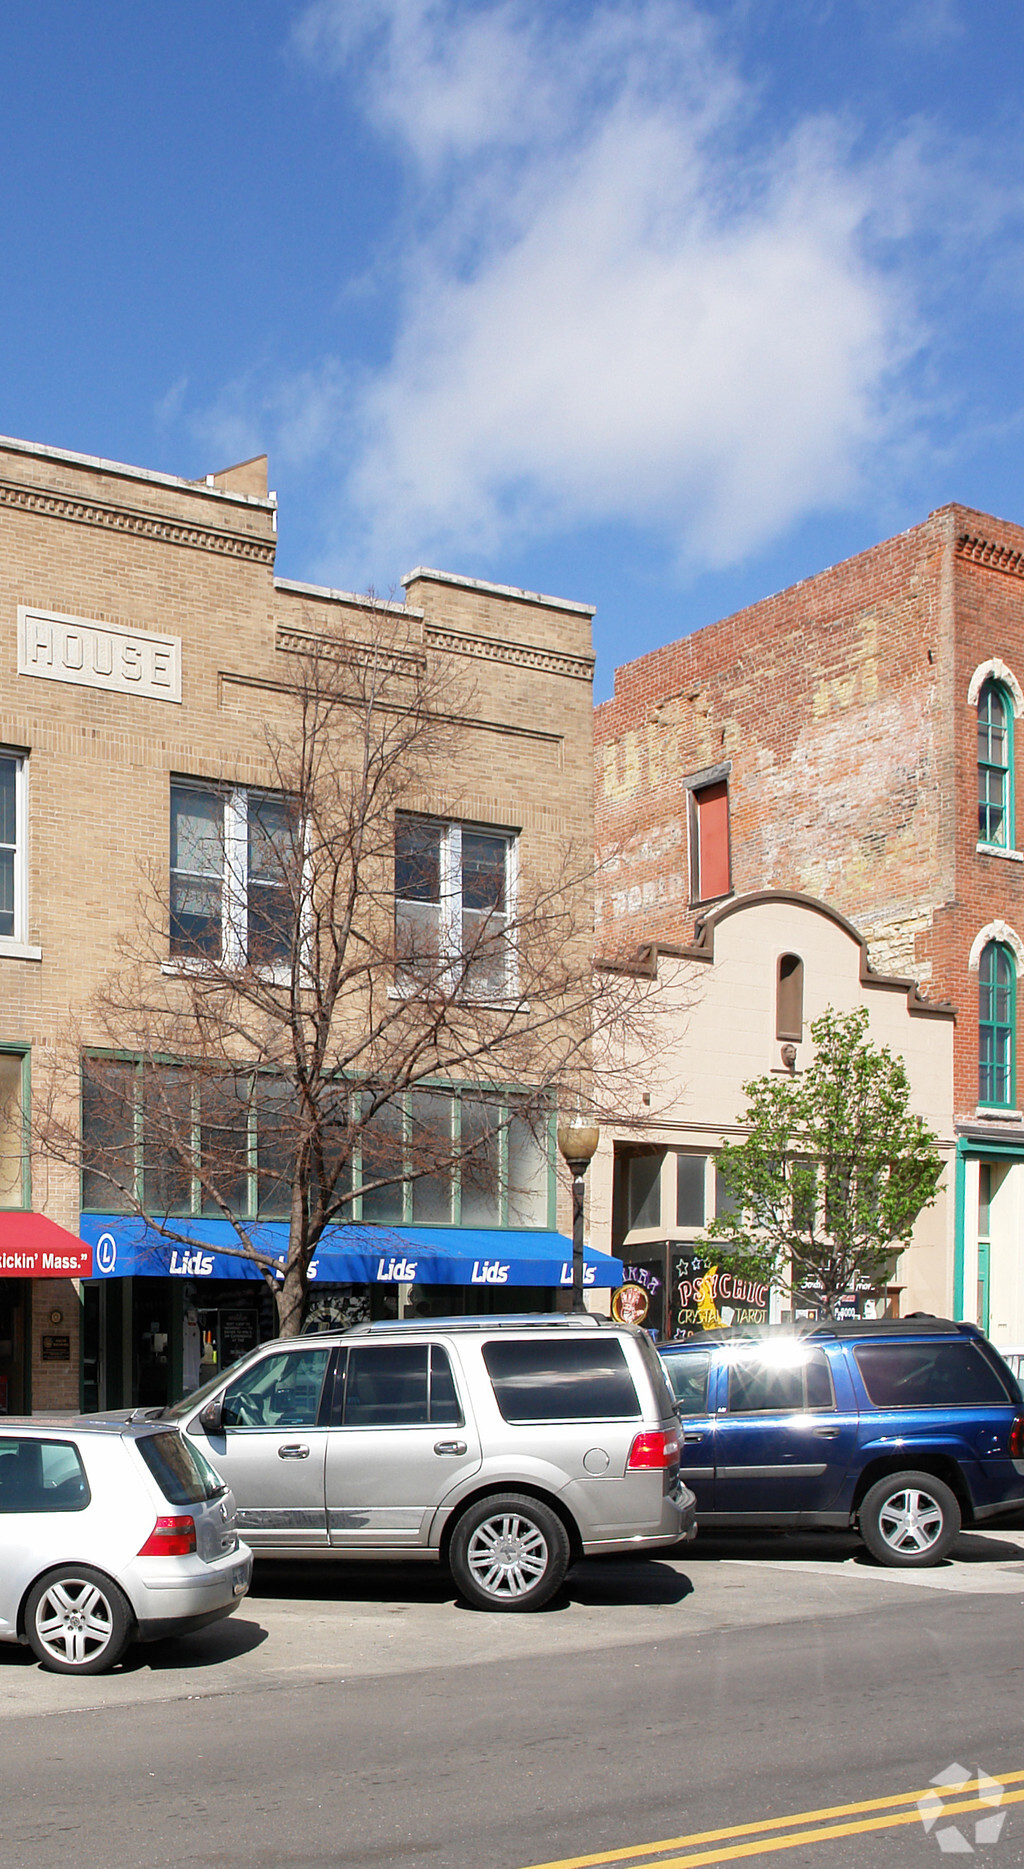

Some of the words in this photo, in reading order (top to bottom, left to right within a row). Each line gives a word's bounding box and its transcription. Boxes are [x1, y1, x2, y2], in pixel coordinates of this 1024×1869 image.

[31, 624, 172, 688] HOUSE
[169, 1250, 215, 1276] Lids
[376, 1257, 418, 1281] Lids
[471, 1260, 510, 1284] Lids
[677, 1272, 769, 1308] PSYCHIC
[734, 1307, 768, 1325] TAROT
